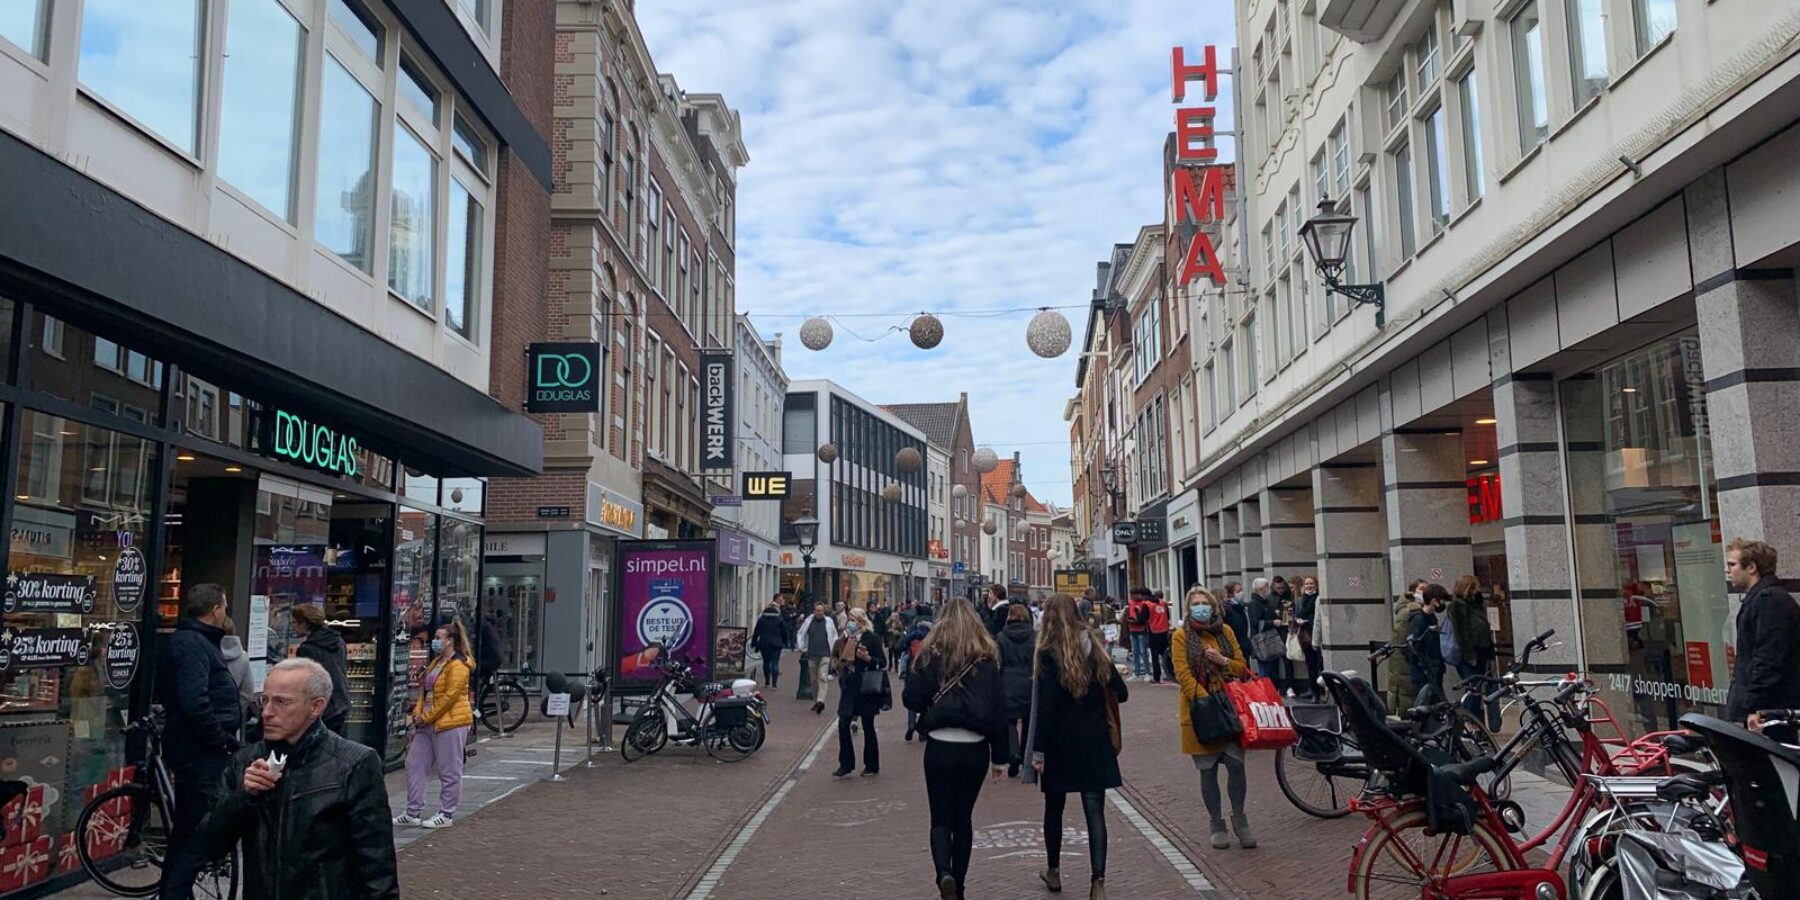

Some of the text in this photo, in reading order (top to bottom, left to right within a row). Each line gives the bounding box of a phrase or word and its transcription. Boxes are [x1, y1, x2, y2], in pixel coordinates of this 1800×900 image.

[1172, 45, 1227, 287] HEMA
[537, 353, 591, 387] DO
[537, 389, 591, 401] DOUGLAS
[707, 363, 725, 460] backWERK
[275, 409, 357, 476] DOUGLAS
[748, 477, 786, 494] WE
[115, 570, 144, 586] korting
[626, 557, 706, 576] simpel.nl
[17, 580, 86, 604] 30% korting
[11, 635, 80, 658] 25% korting
[107, 646, 136, 661] korting
[1609, 673, 1631, 693] 24/7
[1634, 674, 1682, 701] shoppen
[1684, 684, 1700, 705] op
[1249, 701, 1292, 728] Dirk
